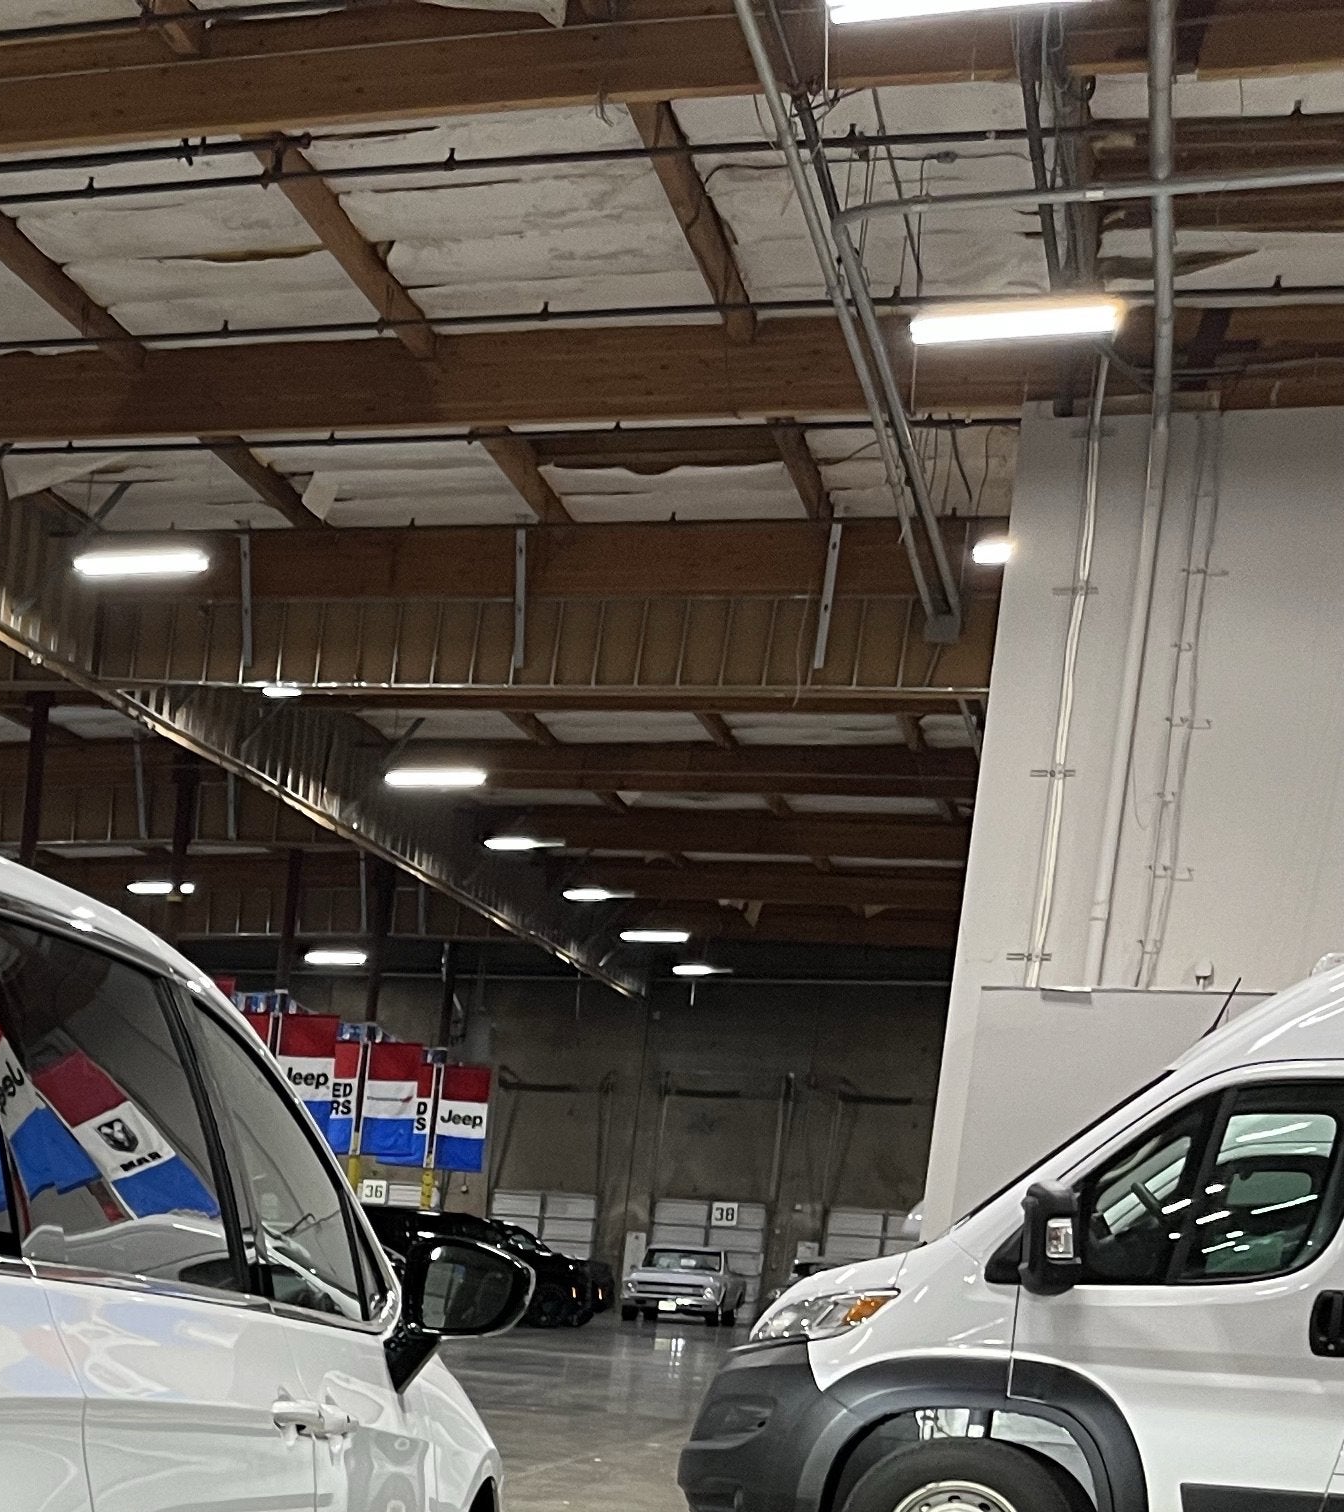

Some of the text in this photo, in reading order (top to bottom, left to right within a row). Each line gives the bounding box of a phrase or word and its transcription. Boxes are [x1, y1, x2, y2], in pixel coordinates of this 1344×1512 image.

[440, 1109, 483, 1129] Jeep
[364, 1185, 384, 1199] 36
[714, 1207, 736, 1222] 38
